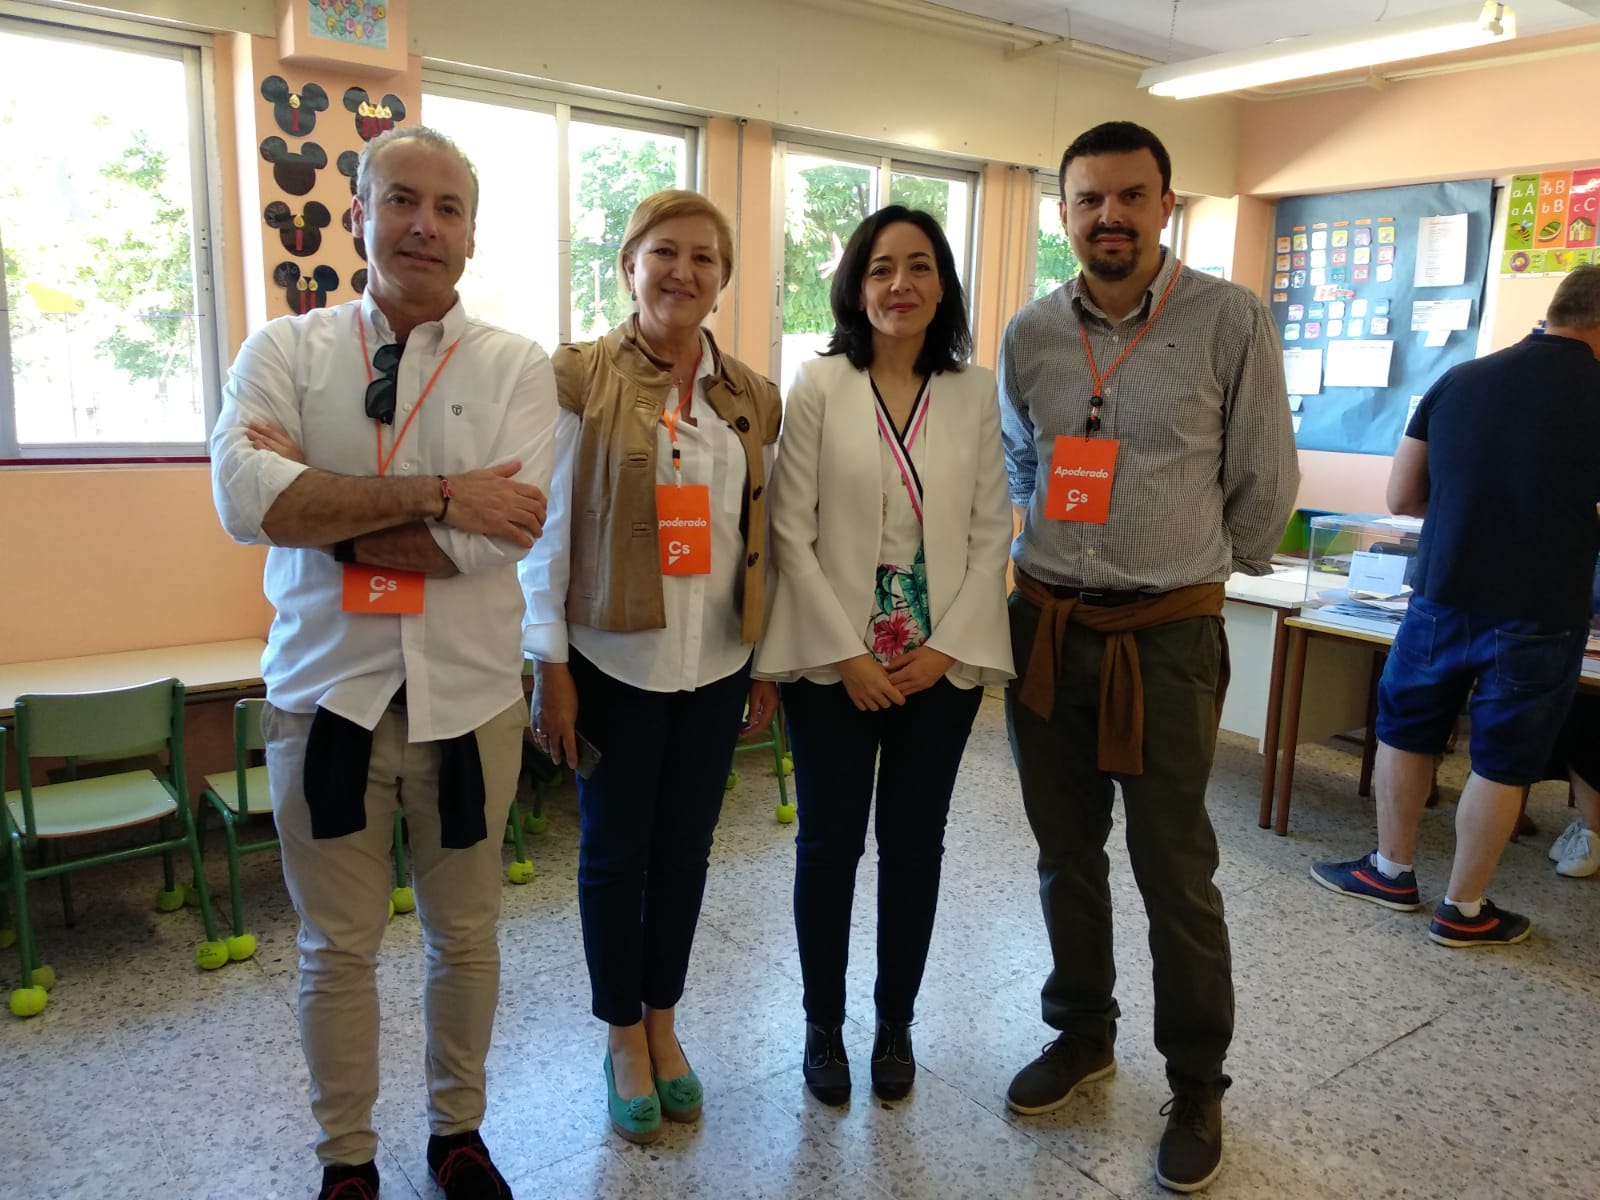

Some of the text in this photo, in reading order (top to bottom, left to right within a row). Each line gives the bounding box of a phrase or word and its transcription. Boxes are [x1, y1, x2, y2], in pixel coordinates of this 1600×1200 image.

[1054, 466, 1109, 479] Apoderado
[1067, 489, 1088, 503] Cs
[658, 517, 707, 529] poderado
[668, 541, 690, 555] Cs
[369, 575, 398, 591] Cs
